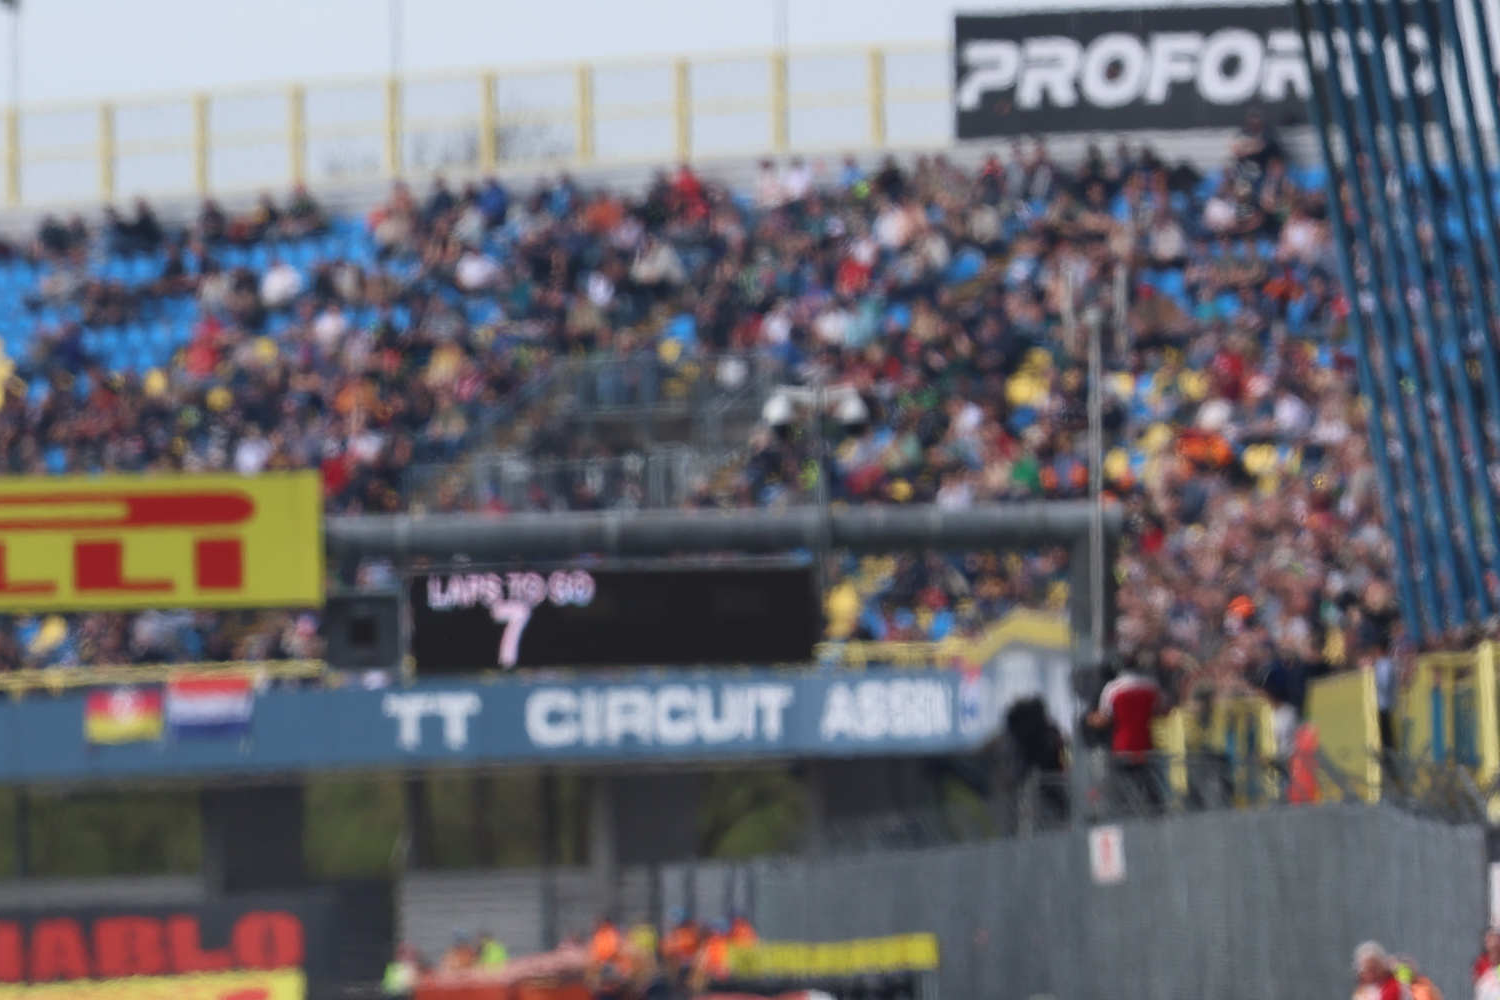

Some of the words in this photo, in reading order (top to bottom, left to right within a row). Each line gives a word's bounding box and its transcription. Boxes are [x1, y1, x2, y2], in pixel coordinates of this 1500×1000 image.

[506, 572, 547, 606] TO
[489, 600, 533, 668] 7
[383, 691, 481, 750] TT
[526, 683, 793, 747] CIRCUIT
